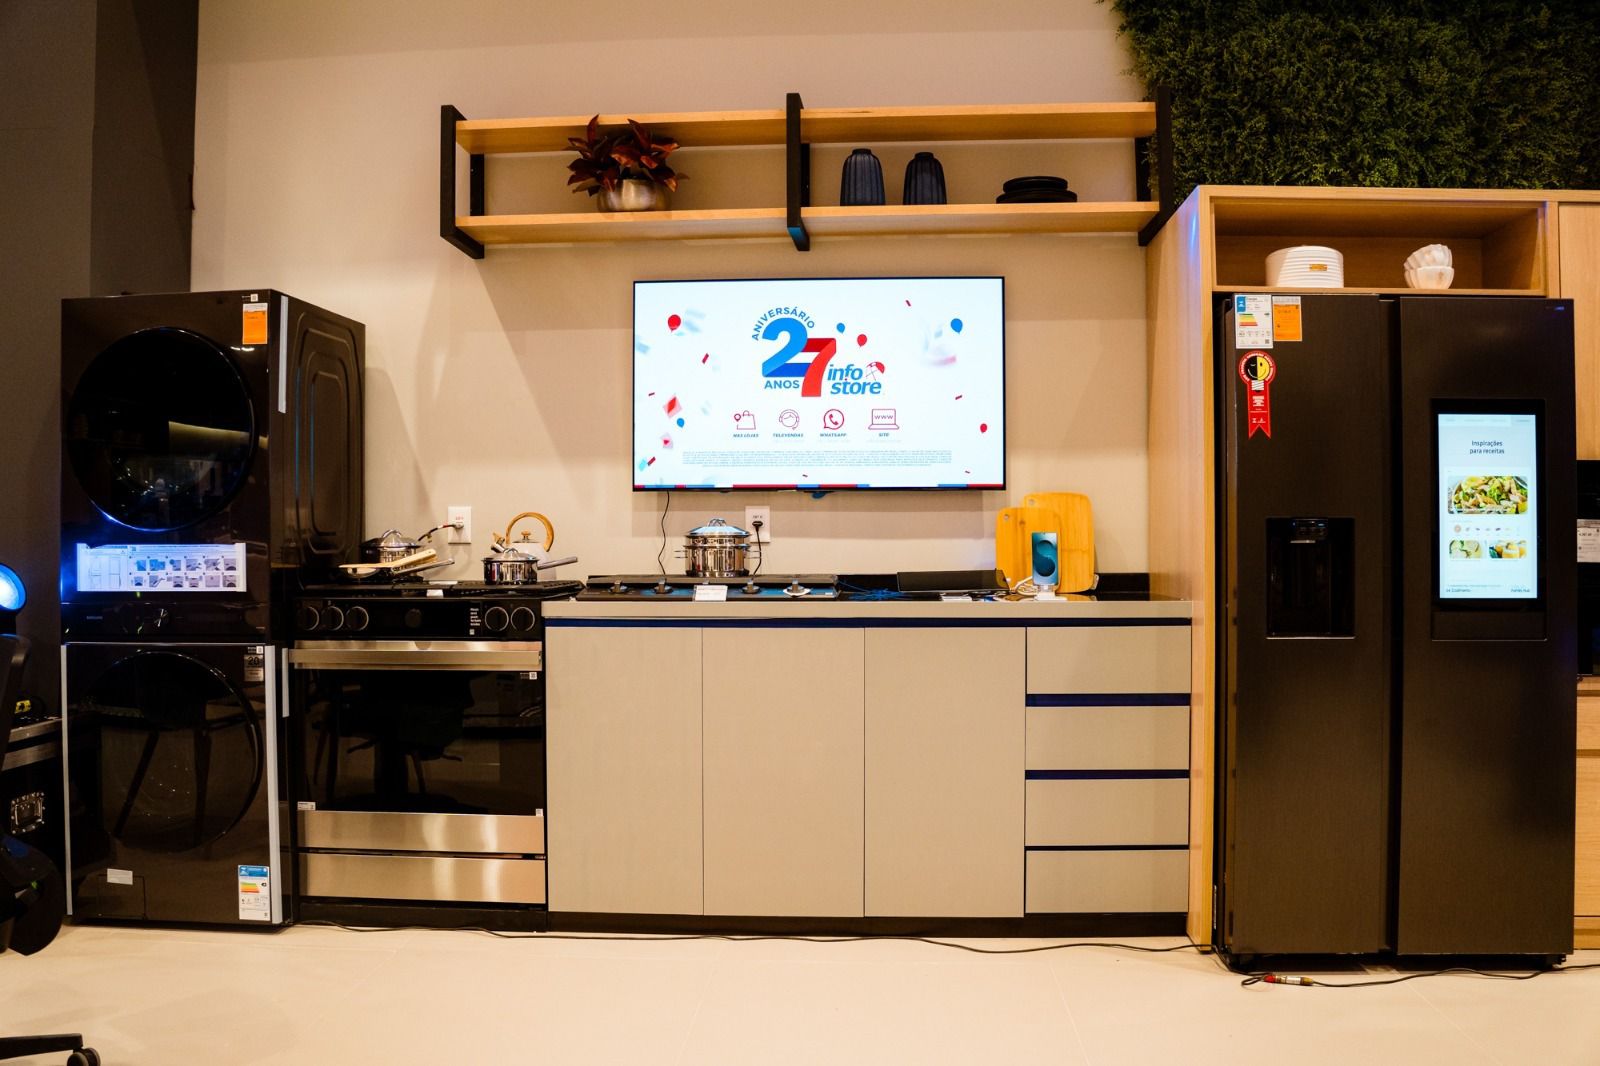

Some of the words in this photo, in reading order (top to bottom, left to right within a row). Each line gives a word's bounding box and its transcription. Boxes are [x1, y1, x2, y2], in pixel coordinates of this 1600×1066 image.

[752, 306, 815, 341] ANIVERSÁRIO
[762, 317, 836, 397] 27
[827, 364, 863, 381] info
[764, 380, 800, 389] ANOS
[830, 381, 881, 395] store
